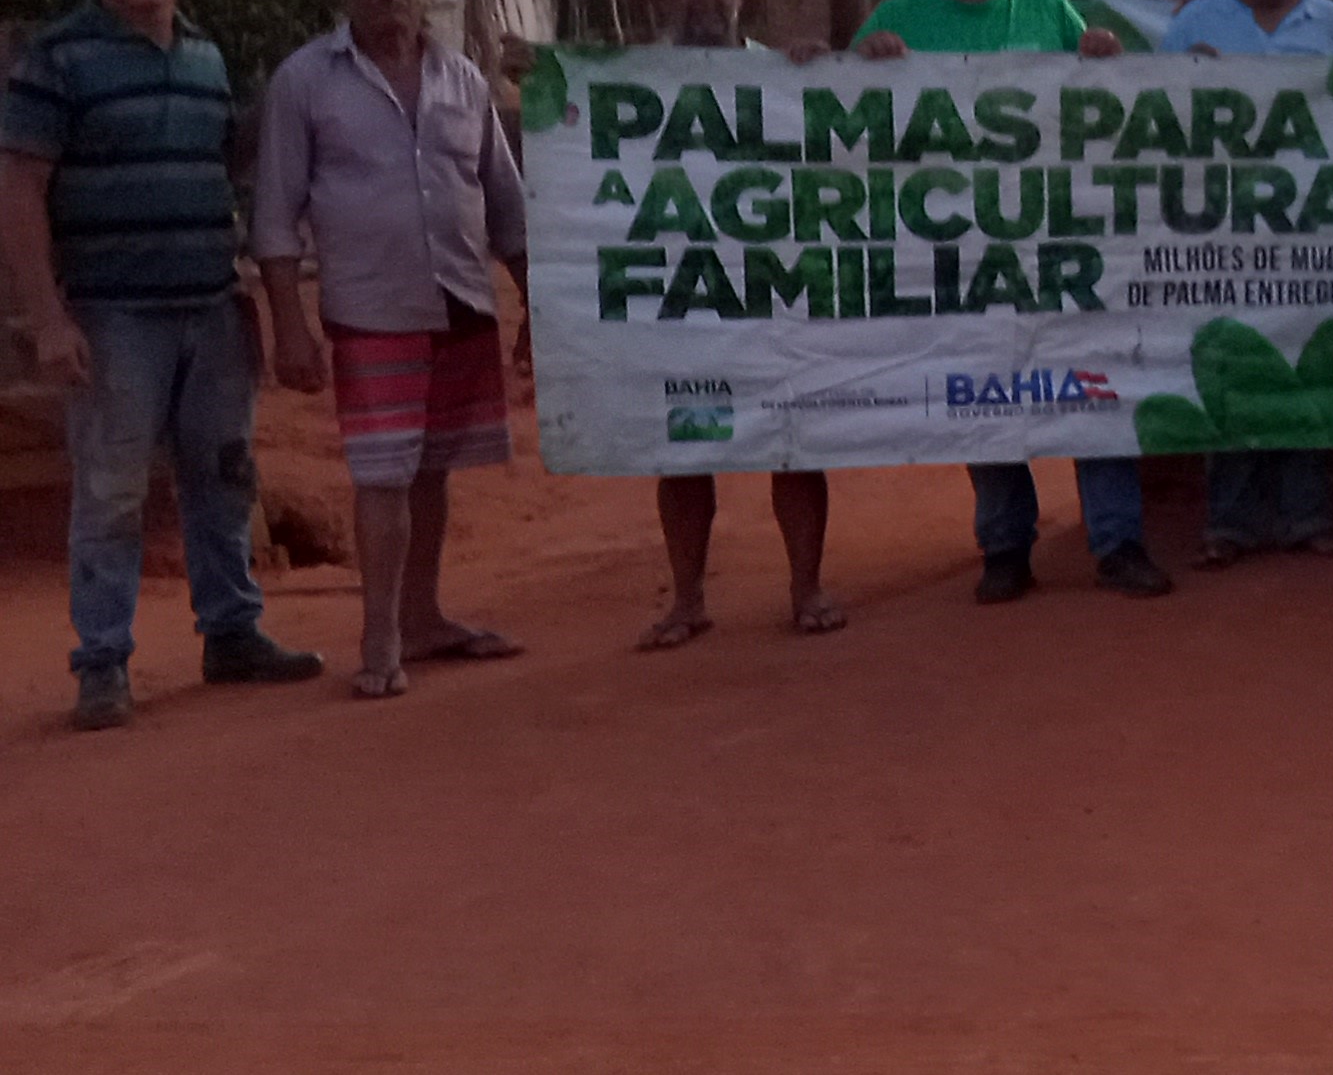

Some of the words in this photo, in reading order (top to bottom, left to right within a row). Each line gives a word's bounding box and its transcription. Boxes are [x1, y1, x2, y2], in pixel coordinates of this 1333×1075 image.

[589, 83, 1043, 162] PALMAS
[1061, 87, 1330, 162] PARA
[593, 169, 637, 206] A
[1143, 242, 1244, 272] MILHÕES
[1253, 245, 1282, 271] DE
[598, 243, 1105, 321] FAMILIAR
[1128, 280, 1151, 306] DE
[1163, 279, 1237, 305] PALMA
[665, 379, 733, 396] BAHIA
[946, 369, 1090, 406] BAHIA
